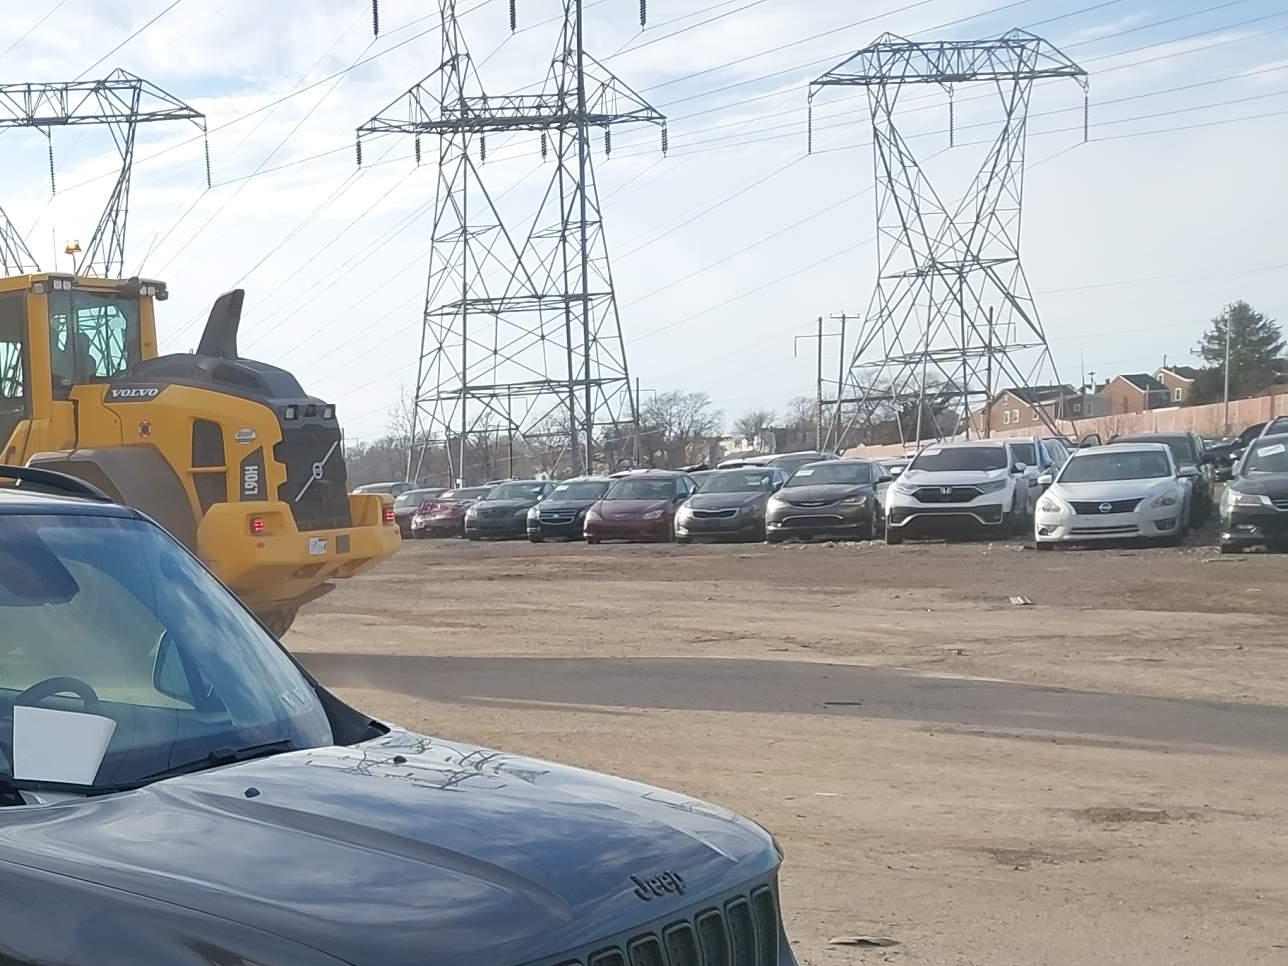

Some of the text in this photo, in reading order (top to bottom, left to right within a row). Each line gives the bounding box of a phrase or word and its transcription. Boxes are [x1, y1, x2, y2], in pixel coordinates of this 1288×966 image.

[111, 388, 159, 398] VOLVO
[244, 465, 259, 495] L90H
[629, 870, 687, 902] Jeep
